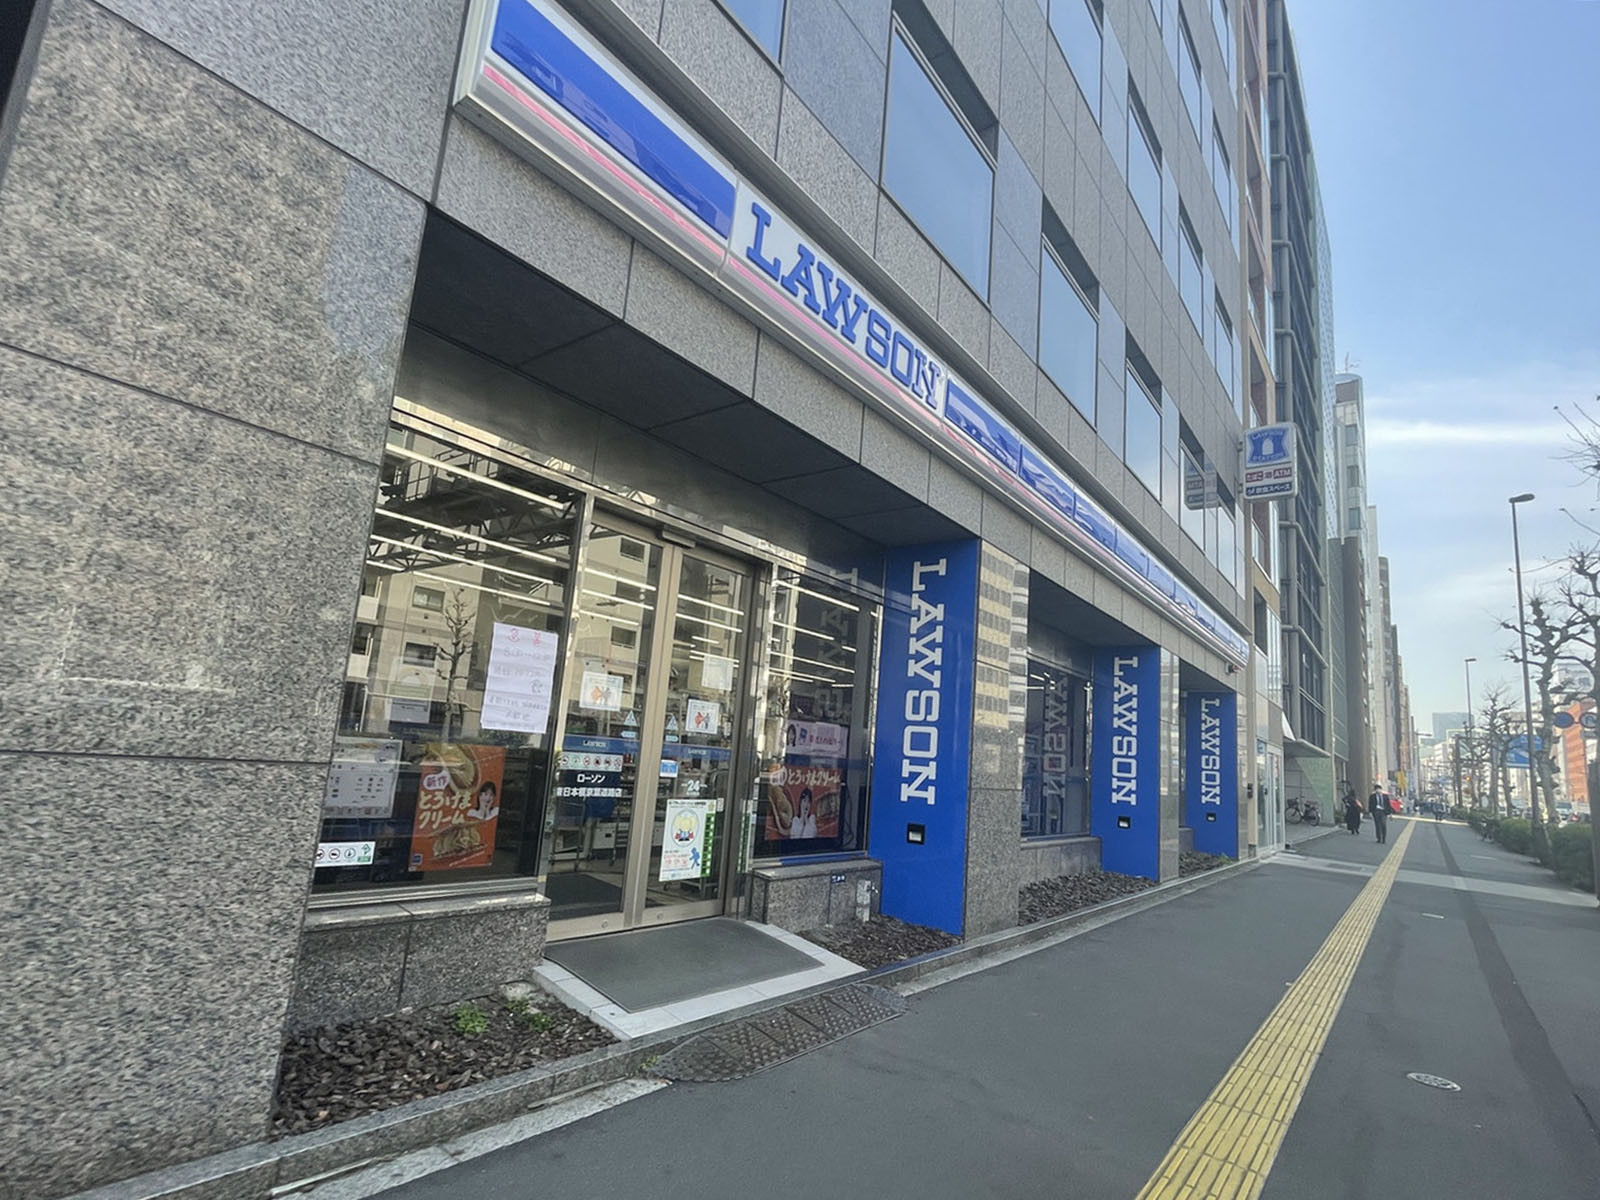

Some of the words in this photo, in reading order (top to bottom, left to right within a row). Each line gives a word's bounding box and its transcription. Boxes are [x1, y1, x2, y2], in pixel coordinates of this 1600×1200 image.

[746, 202, 942, 410] LAWSON
[1274, 468, 1291, 478] ATM
[900, 558, 947, 805] LAWSON
[1111, 656, 1138, 805] LAWSON
[577, 773, 605, 783] ローソン
[1201, 698, 1220, 805] LAWSON
[419, 810, 465, 829] クリーム
